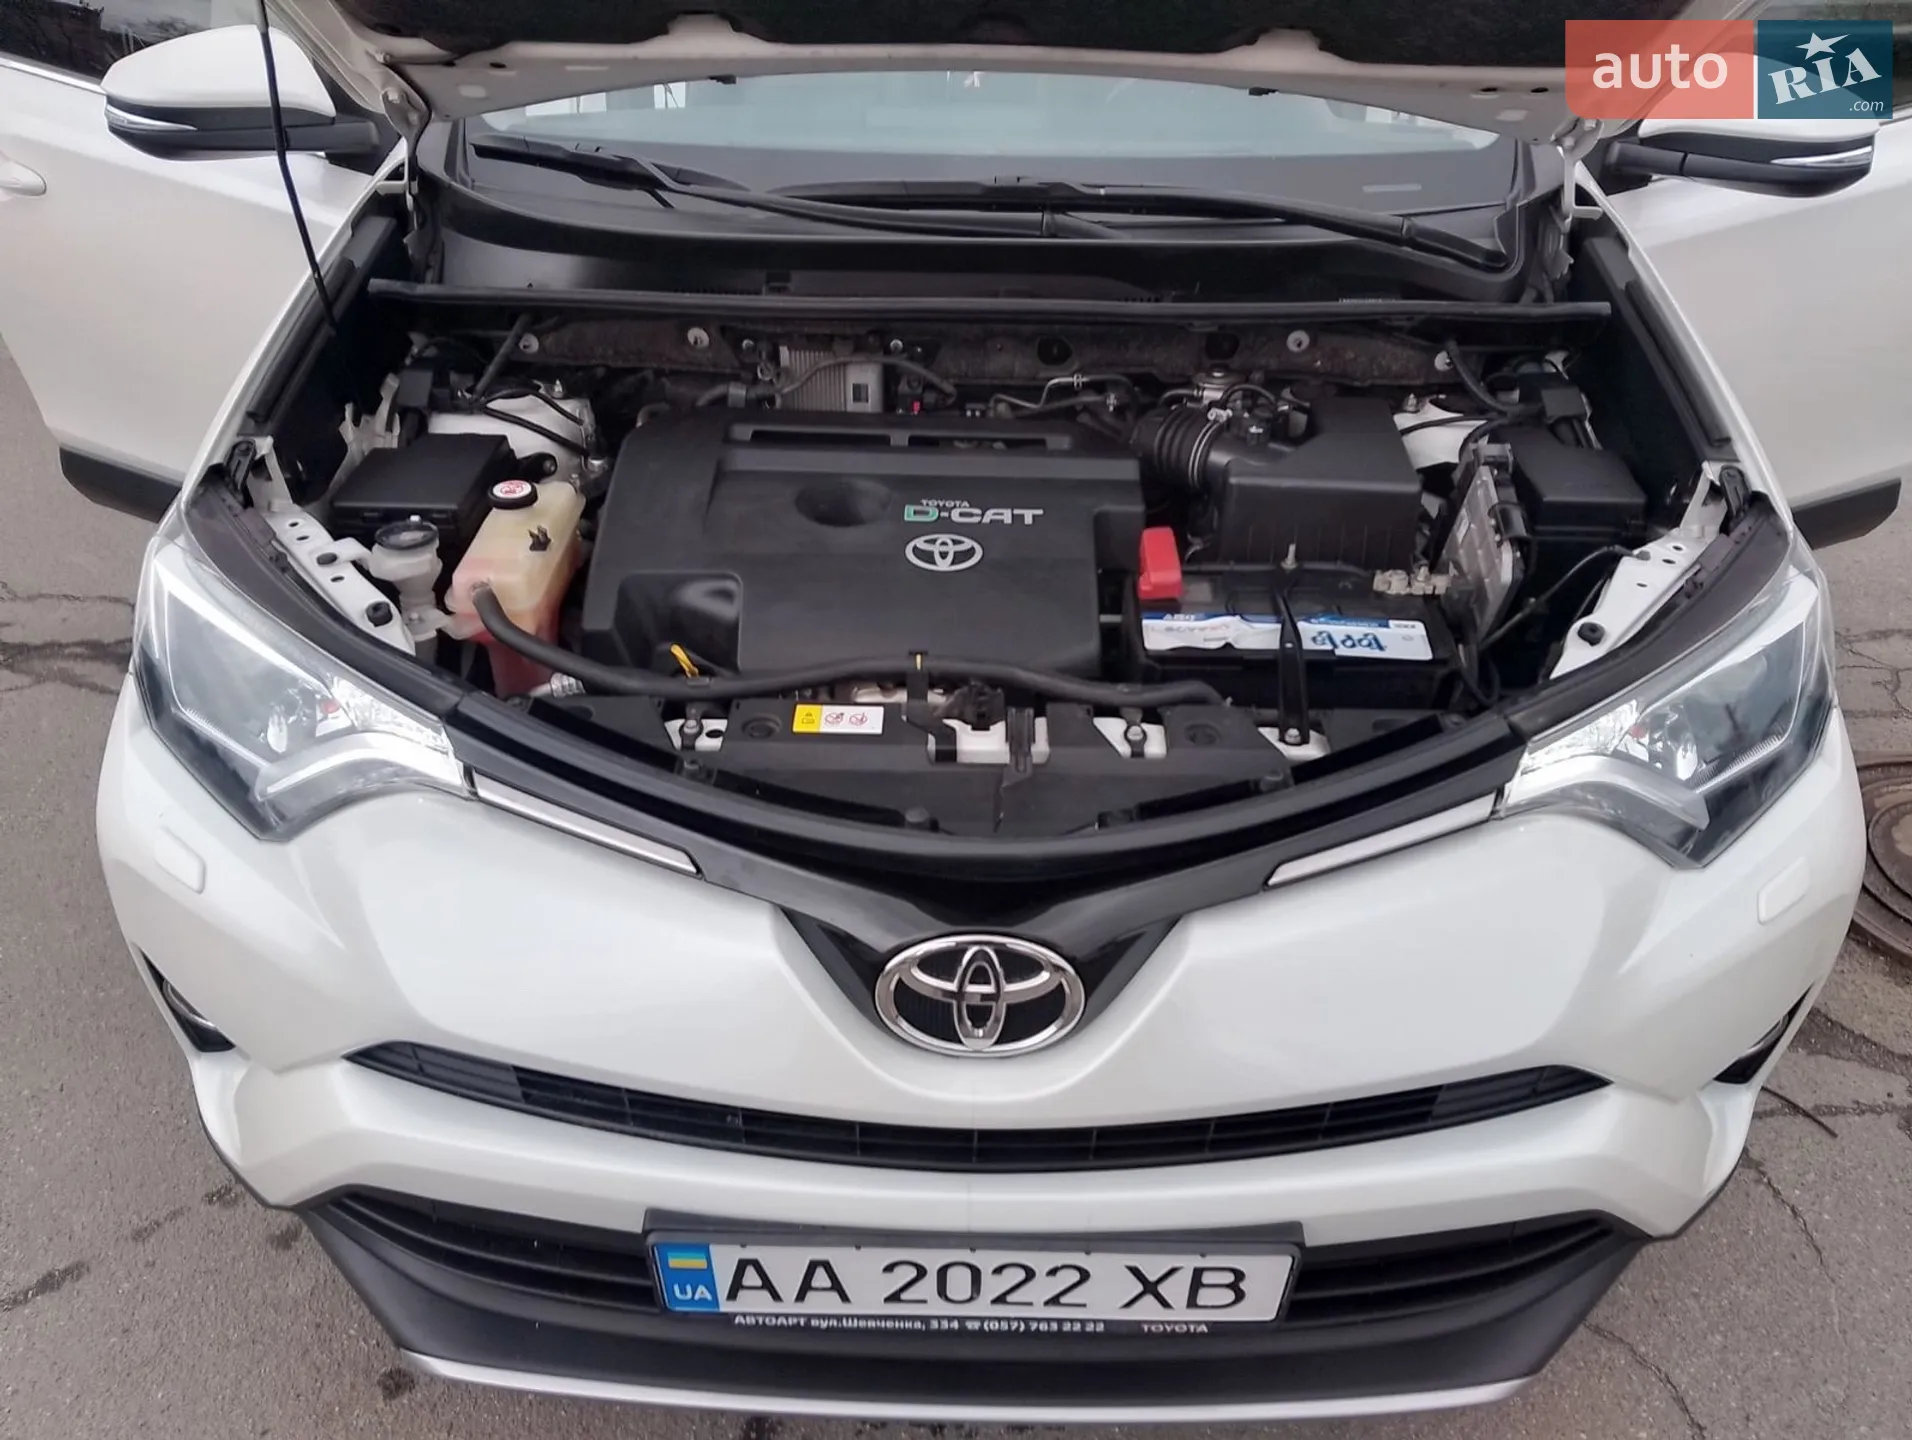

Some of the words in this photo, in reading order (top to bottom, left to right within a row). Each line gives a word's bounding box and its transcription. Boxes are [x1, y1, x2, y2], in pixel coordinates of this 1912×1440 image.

[921, 499, 970, 508] TOYOTA
[904, 504, 1044, 525] D-CAT
[672, 1283, 713, 1301] UA
[726, 1258, 853, 1304] AA
[882, 1260, 1092, 1308] 2022
[1118, 1264, 1247, 1310] XB
[1141, 1323, 1209, 1334] TOYOTA
